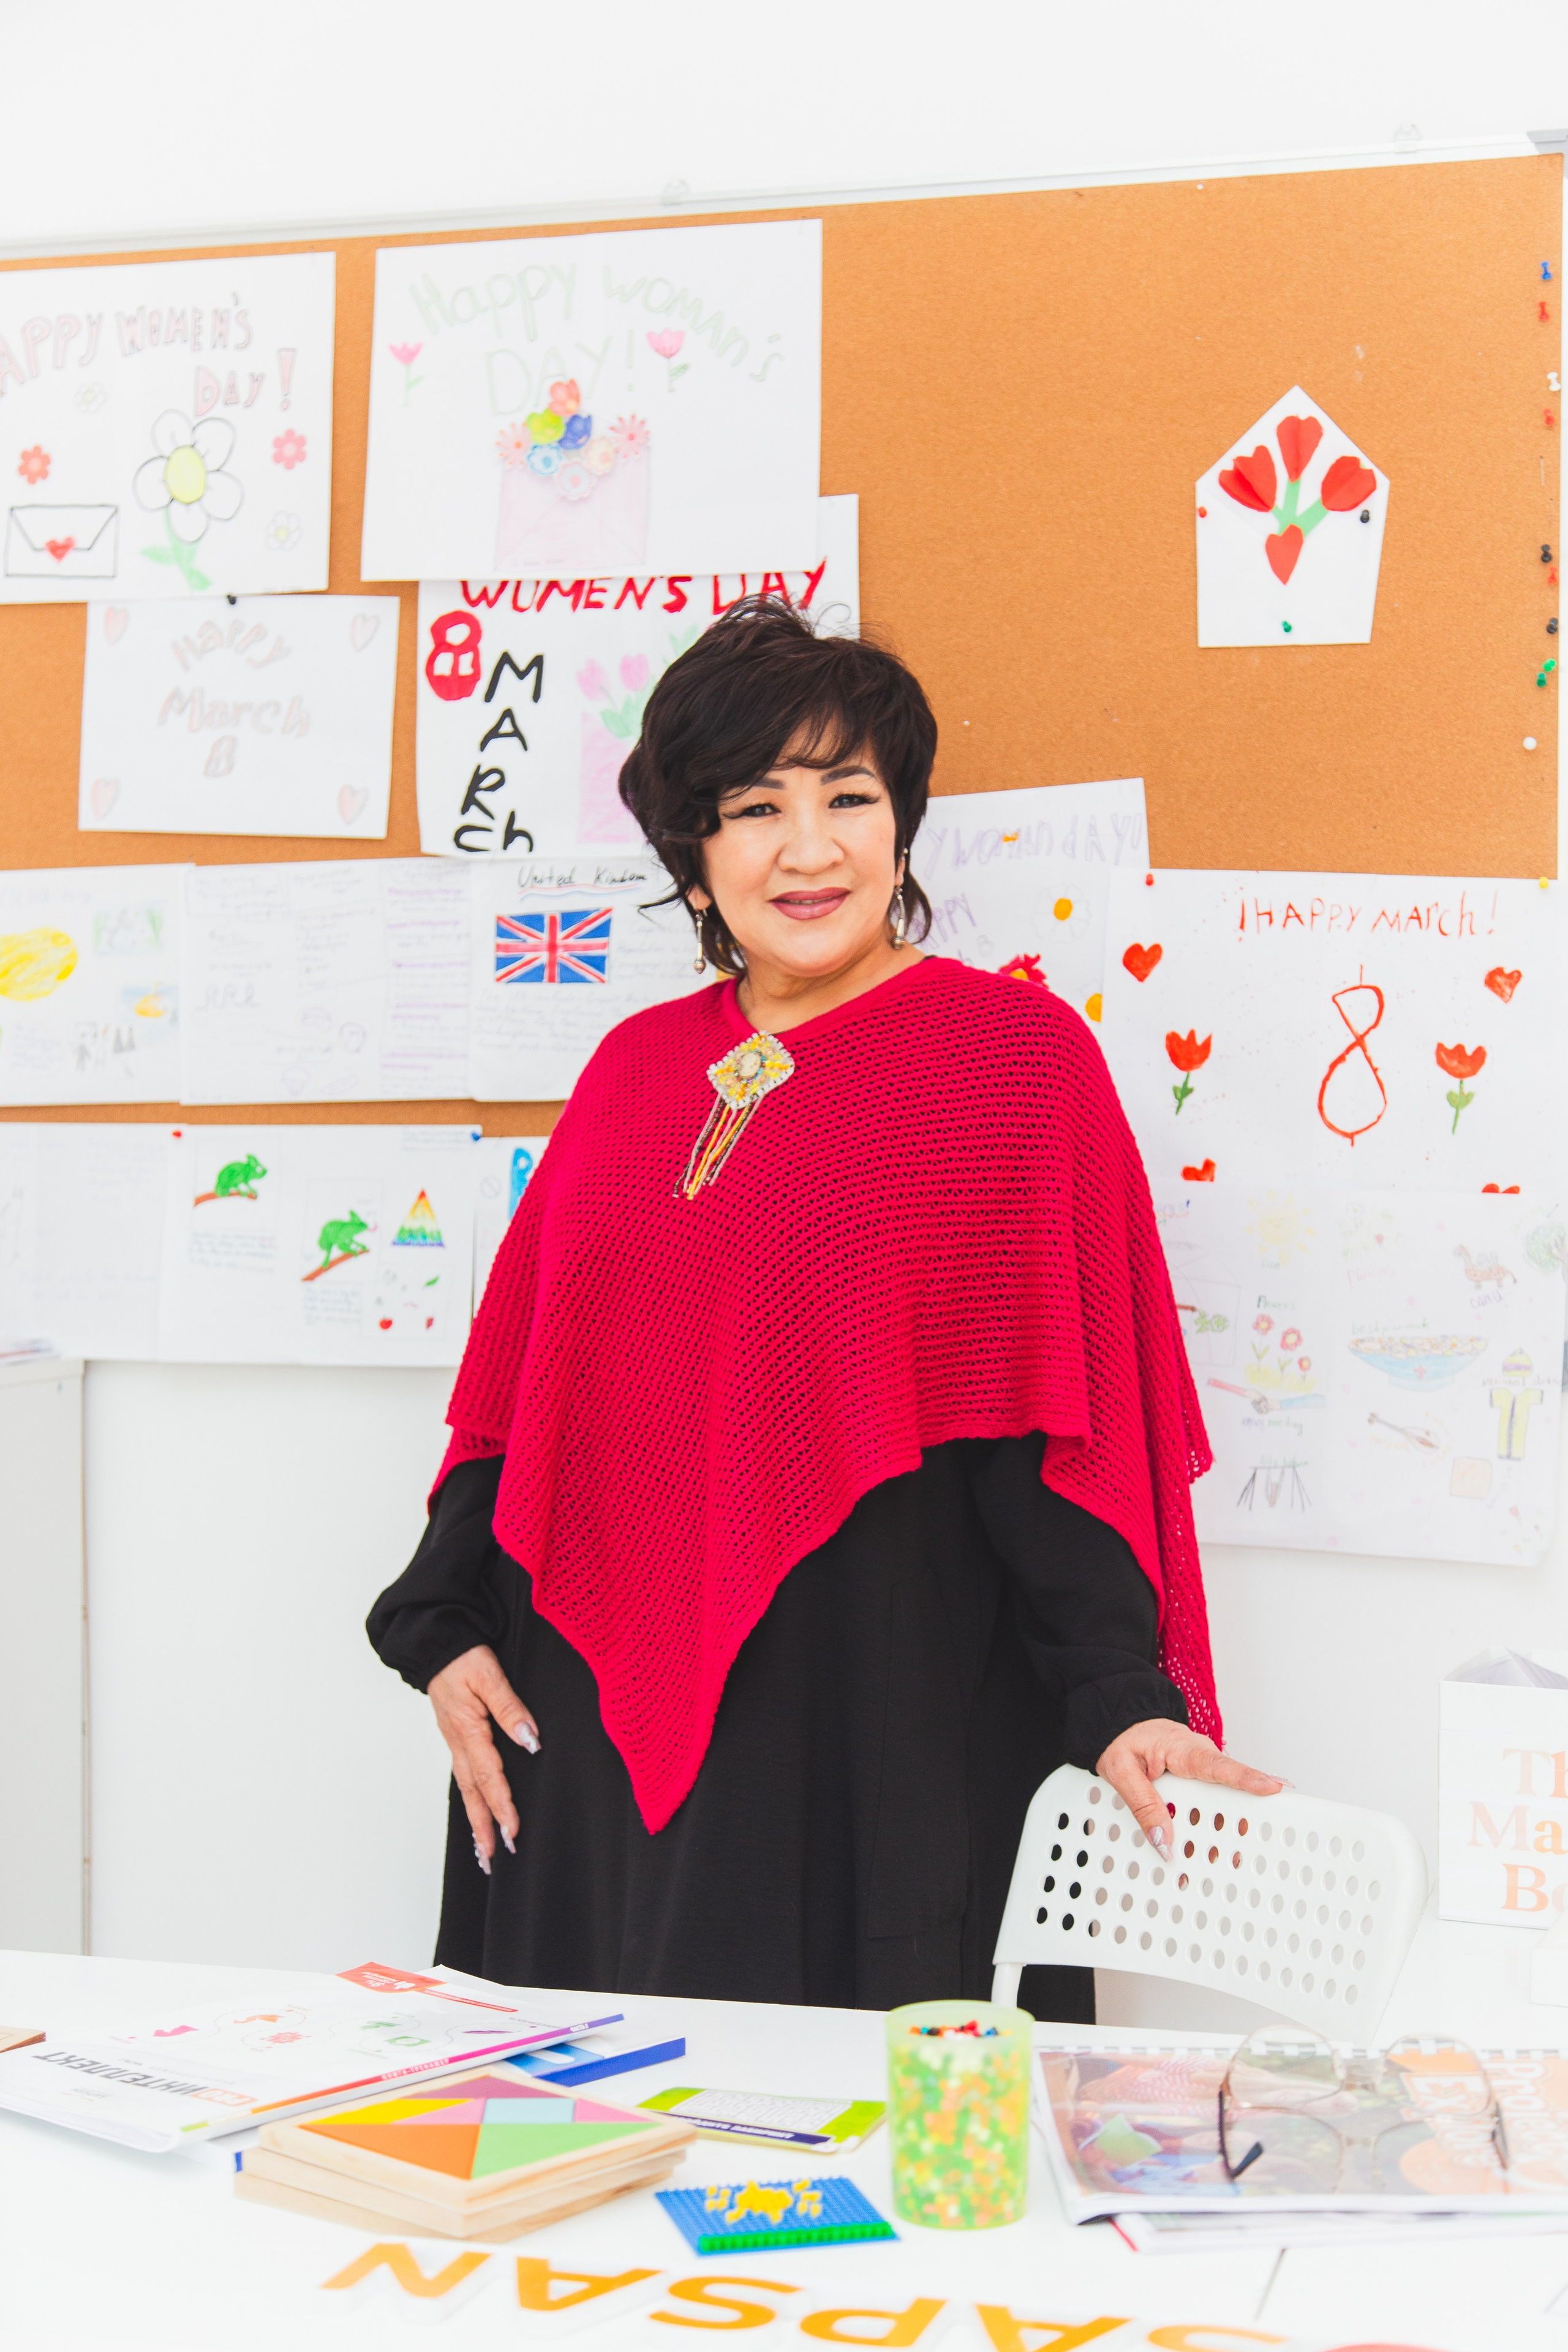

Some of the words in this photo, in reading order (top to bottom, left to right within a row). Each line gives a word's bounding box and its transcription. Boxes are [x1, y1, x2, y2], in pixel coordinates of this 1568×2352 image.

[408, 261, 578, 342] Happy
[170, 618, 292, 672] Happy
[425, 610, 483, 701] 8
[156, 685, 309, 738] March
[516, 862, 578, 889] United
